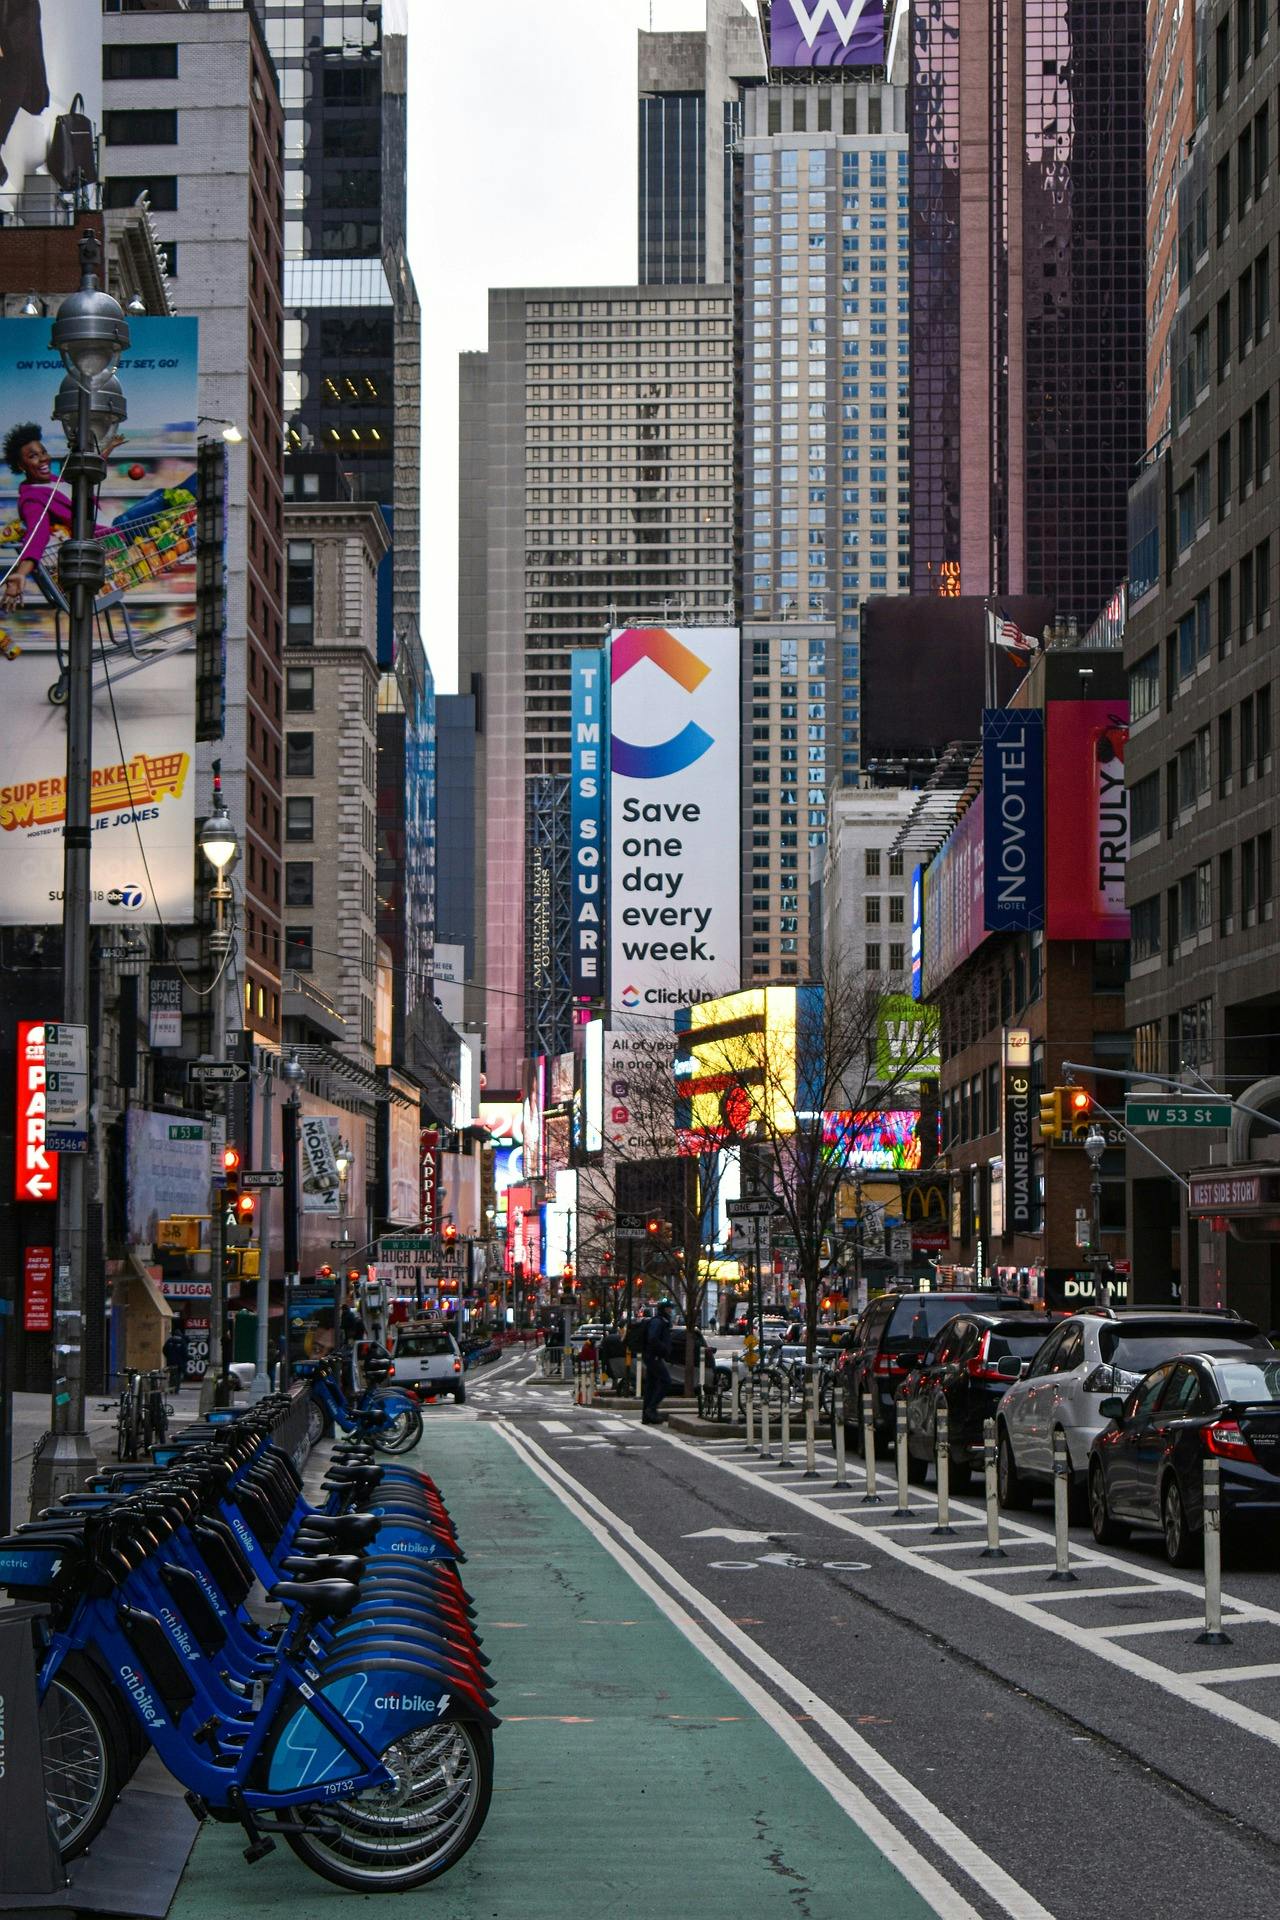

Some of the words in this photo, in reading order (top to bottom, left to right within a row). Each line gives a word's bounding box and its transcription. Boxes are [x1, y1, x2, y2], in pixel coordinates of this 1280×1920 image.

[17, 361, 32, 370] ON
[117, 360, 132, 369] ET
[133, 360, 155, 371] SET,
[159, 359, 178, 369] GO!
[577, 668, 599, 798] TIMES
[1, 763, 140, 804] SUPERRKET
[0, 796, 66, 828] SWEE
[113, 807, 160, 826] JONES
[622, 798, 701, 823] Save
[996, 727, 1026, 902] NOVOTEL
[27, 828, 52, 838] HOSTED
[1099, 769, 1128, 890] TRULY
[622, 837, 683, 857] one
[534, 847, 542, 896] EAGLE
[622, 867, 683, 898] day
[108, 892, 124, 901] abc
[577, 819, 599, 978] SQUARE
[542, 867, 550, 967] OUTFITTERS
[622, 907, 713, 932] every
[534, 901, 542, 988] AMERICAN
[622, 936, 716, 961] week.
[151, 980, 182, 991] OFFICE
[151, 992, 182, 1003] SPACE
[644, 988, 714, 1004] ClickUp
[48, 1026, 56, 1042] 2
[25, 1046, 45, 1055] CIT
[612, 1039, 629, 1050] All
[632, 1038, 646, 1050] of
[612, 1058, 624, 1069] in
[628, 1061, 653, 1069] one
[197, 1067, 215, 1077] ONE
[222, 1067, 242, 1077] WAY
[49, 1074, 57, 1090] 6
[25, 1065, 50, 1170] PARK
[1146, 1109, 1160, 1122] W
[1165, 1109, 1187, 1122] 53
[1194, 1109, 1213, 1122] St
[171, 1127, 178, 1138] W
[181, 1127, 190, 1138] 53
[248, 1175, 263, 1183] ONE
[268, 1175, 284, 1184] WAY
[1194, 1183, 1213, 1205] WEST
[1213, 1182, 1231, 1204] SIDE
[1232, 1179, 1256, 1203] STORY
[735, 1203, 751, 1212] ONE
[758, 1202, 775, 1211] WAY
[748, 1225, 768, 1234] TURN
[894, 1239, 910, 1249] 25
[381, 1250, 411, 1263] HUGH
[162, 1284, 170, 1294] &
[174, 1284, 212, 1295] LUGGA
[186, 1318, 208, 1327] SALE
[187, 1341, 209, 1356] 50
[323, 1780, 355, 1795] 79732
